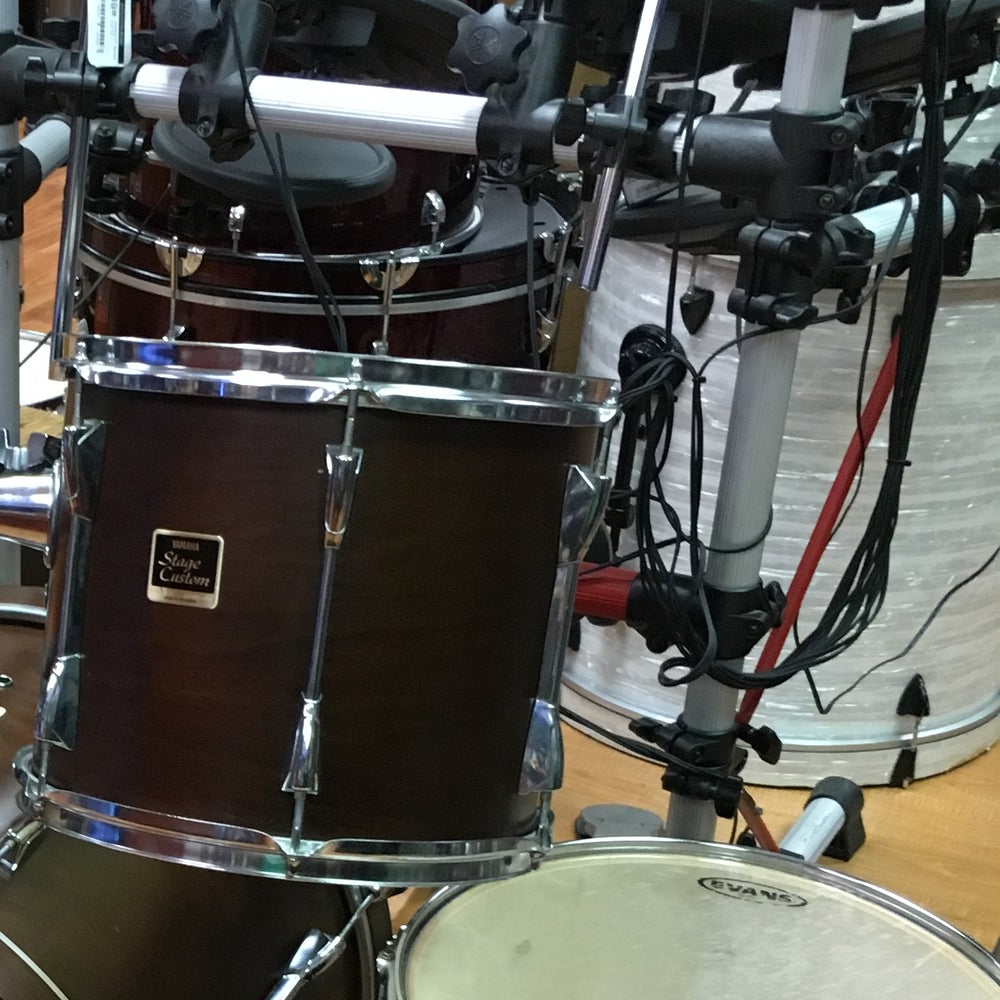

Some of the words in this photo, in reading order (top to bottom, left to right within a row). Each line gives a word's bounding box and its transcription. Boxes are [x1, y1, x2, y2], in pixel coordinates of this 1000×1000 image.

[157, 550, 202, 573] Stage
[160, 566, 211, 587] Custom
[711, 880, 792, 903] EVANS
